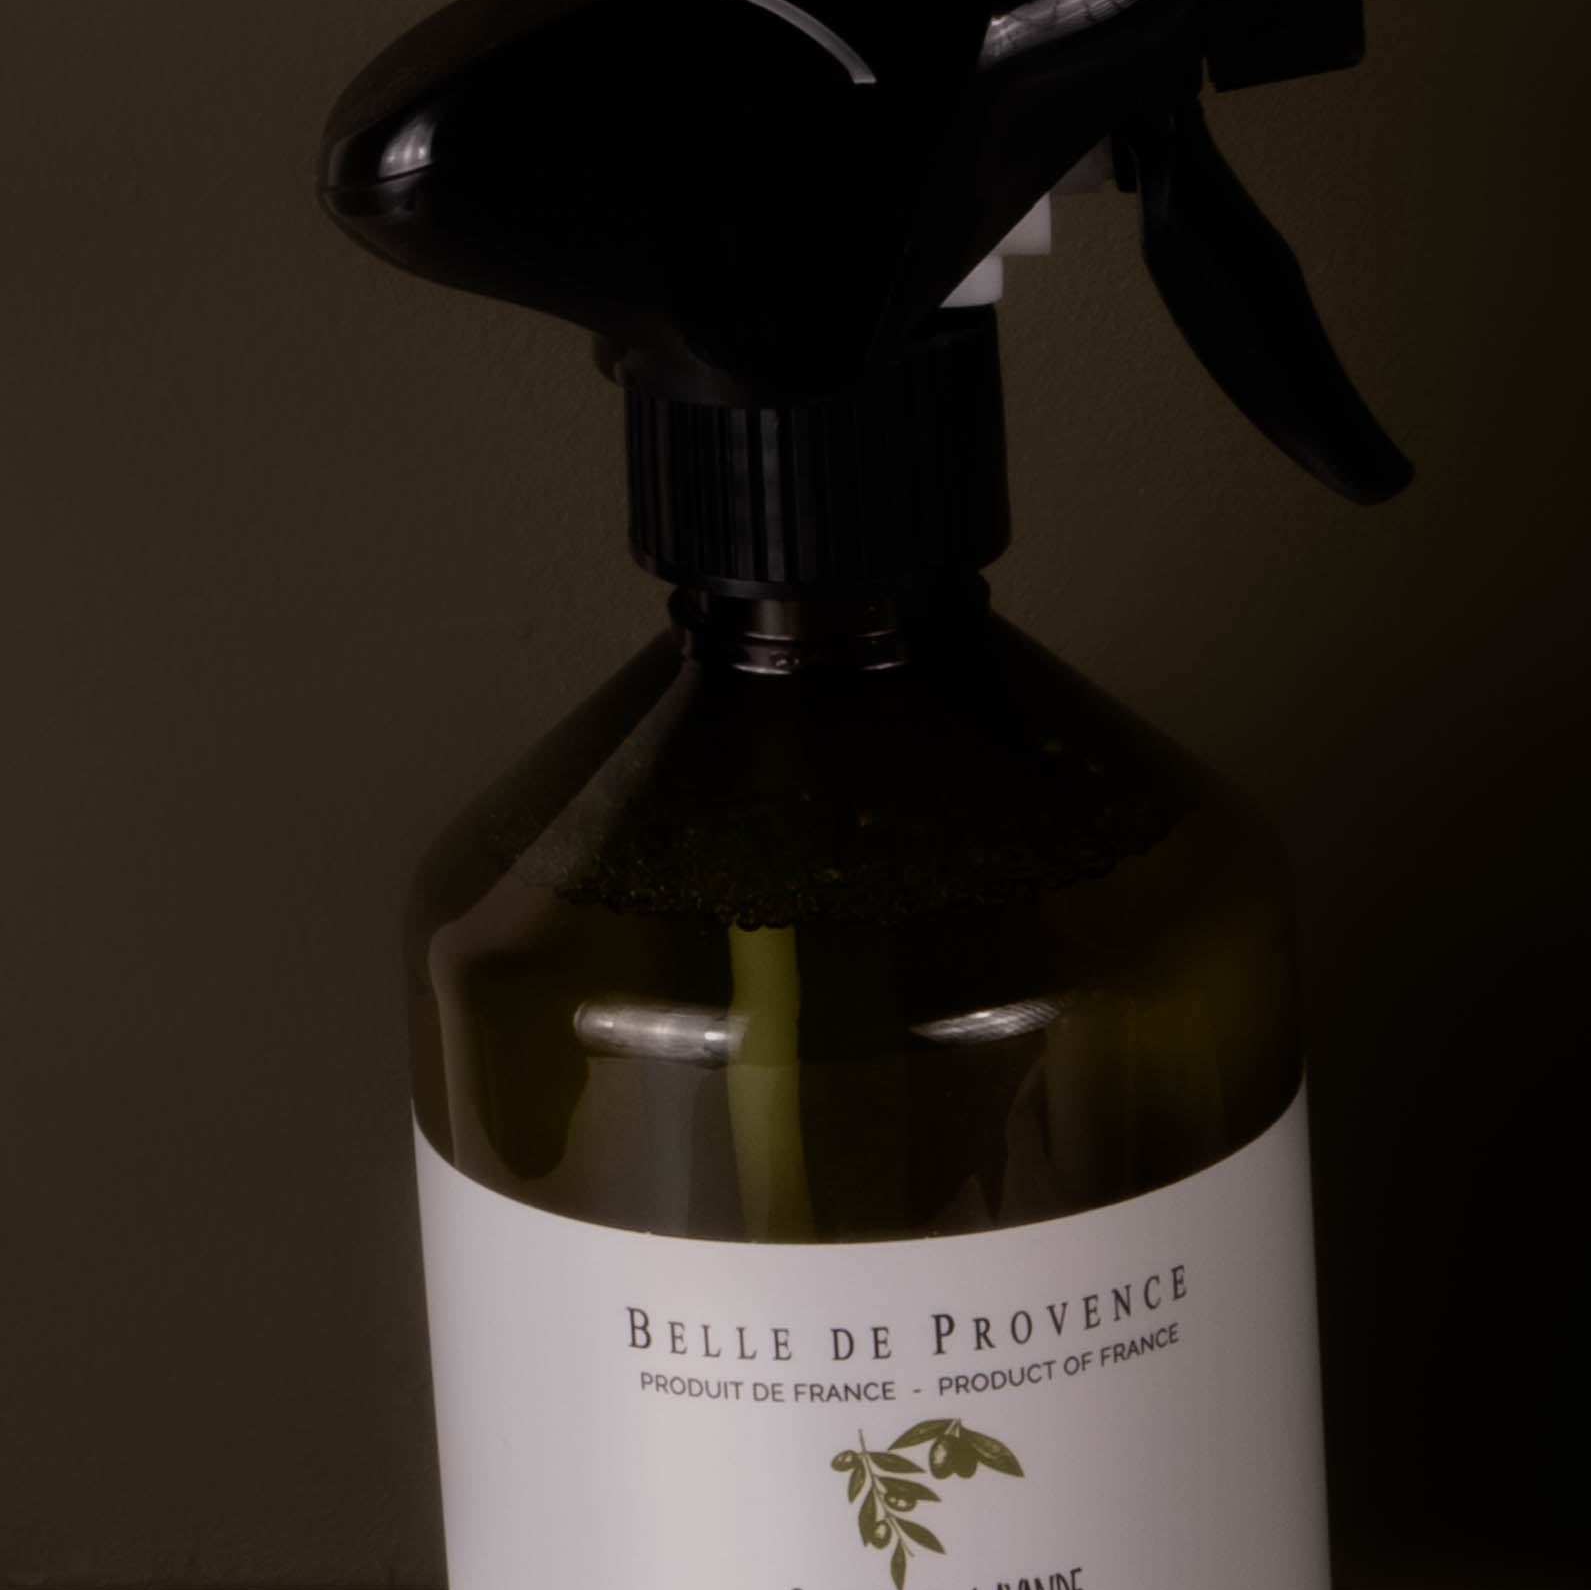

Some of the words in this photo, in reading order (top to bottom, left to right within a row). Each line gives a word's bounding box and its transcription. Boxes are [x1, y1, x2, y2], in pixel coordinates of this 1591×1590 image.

[626, 1306, 792, 1360] BELLE
[831, 1327, 892, 1360] DE
[931, 1264, 1187, 1355] PROVENCE
[640, 1371, 743, 1400] PRODUIT
[753, 1382, 785, 1402] DE
[794, 1381, 896, 1402] FRANCE
[939, 1360, 1056, 1396] PRODUCT
[1063, 1352, 1093, 1376] OF
[1100, 1323, 1179, 1366] FRANCE
